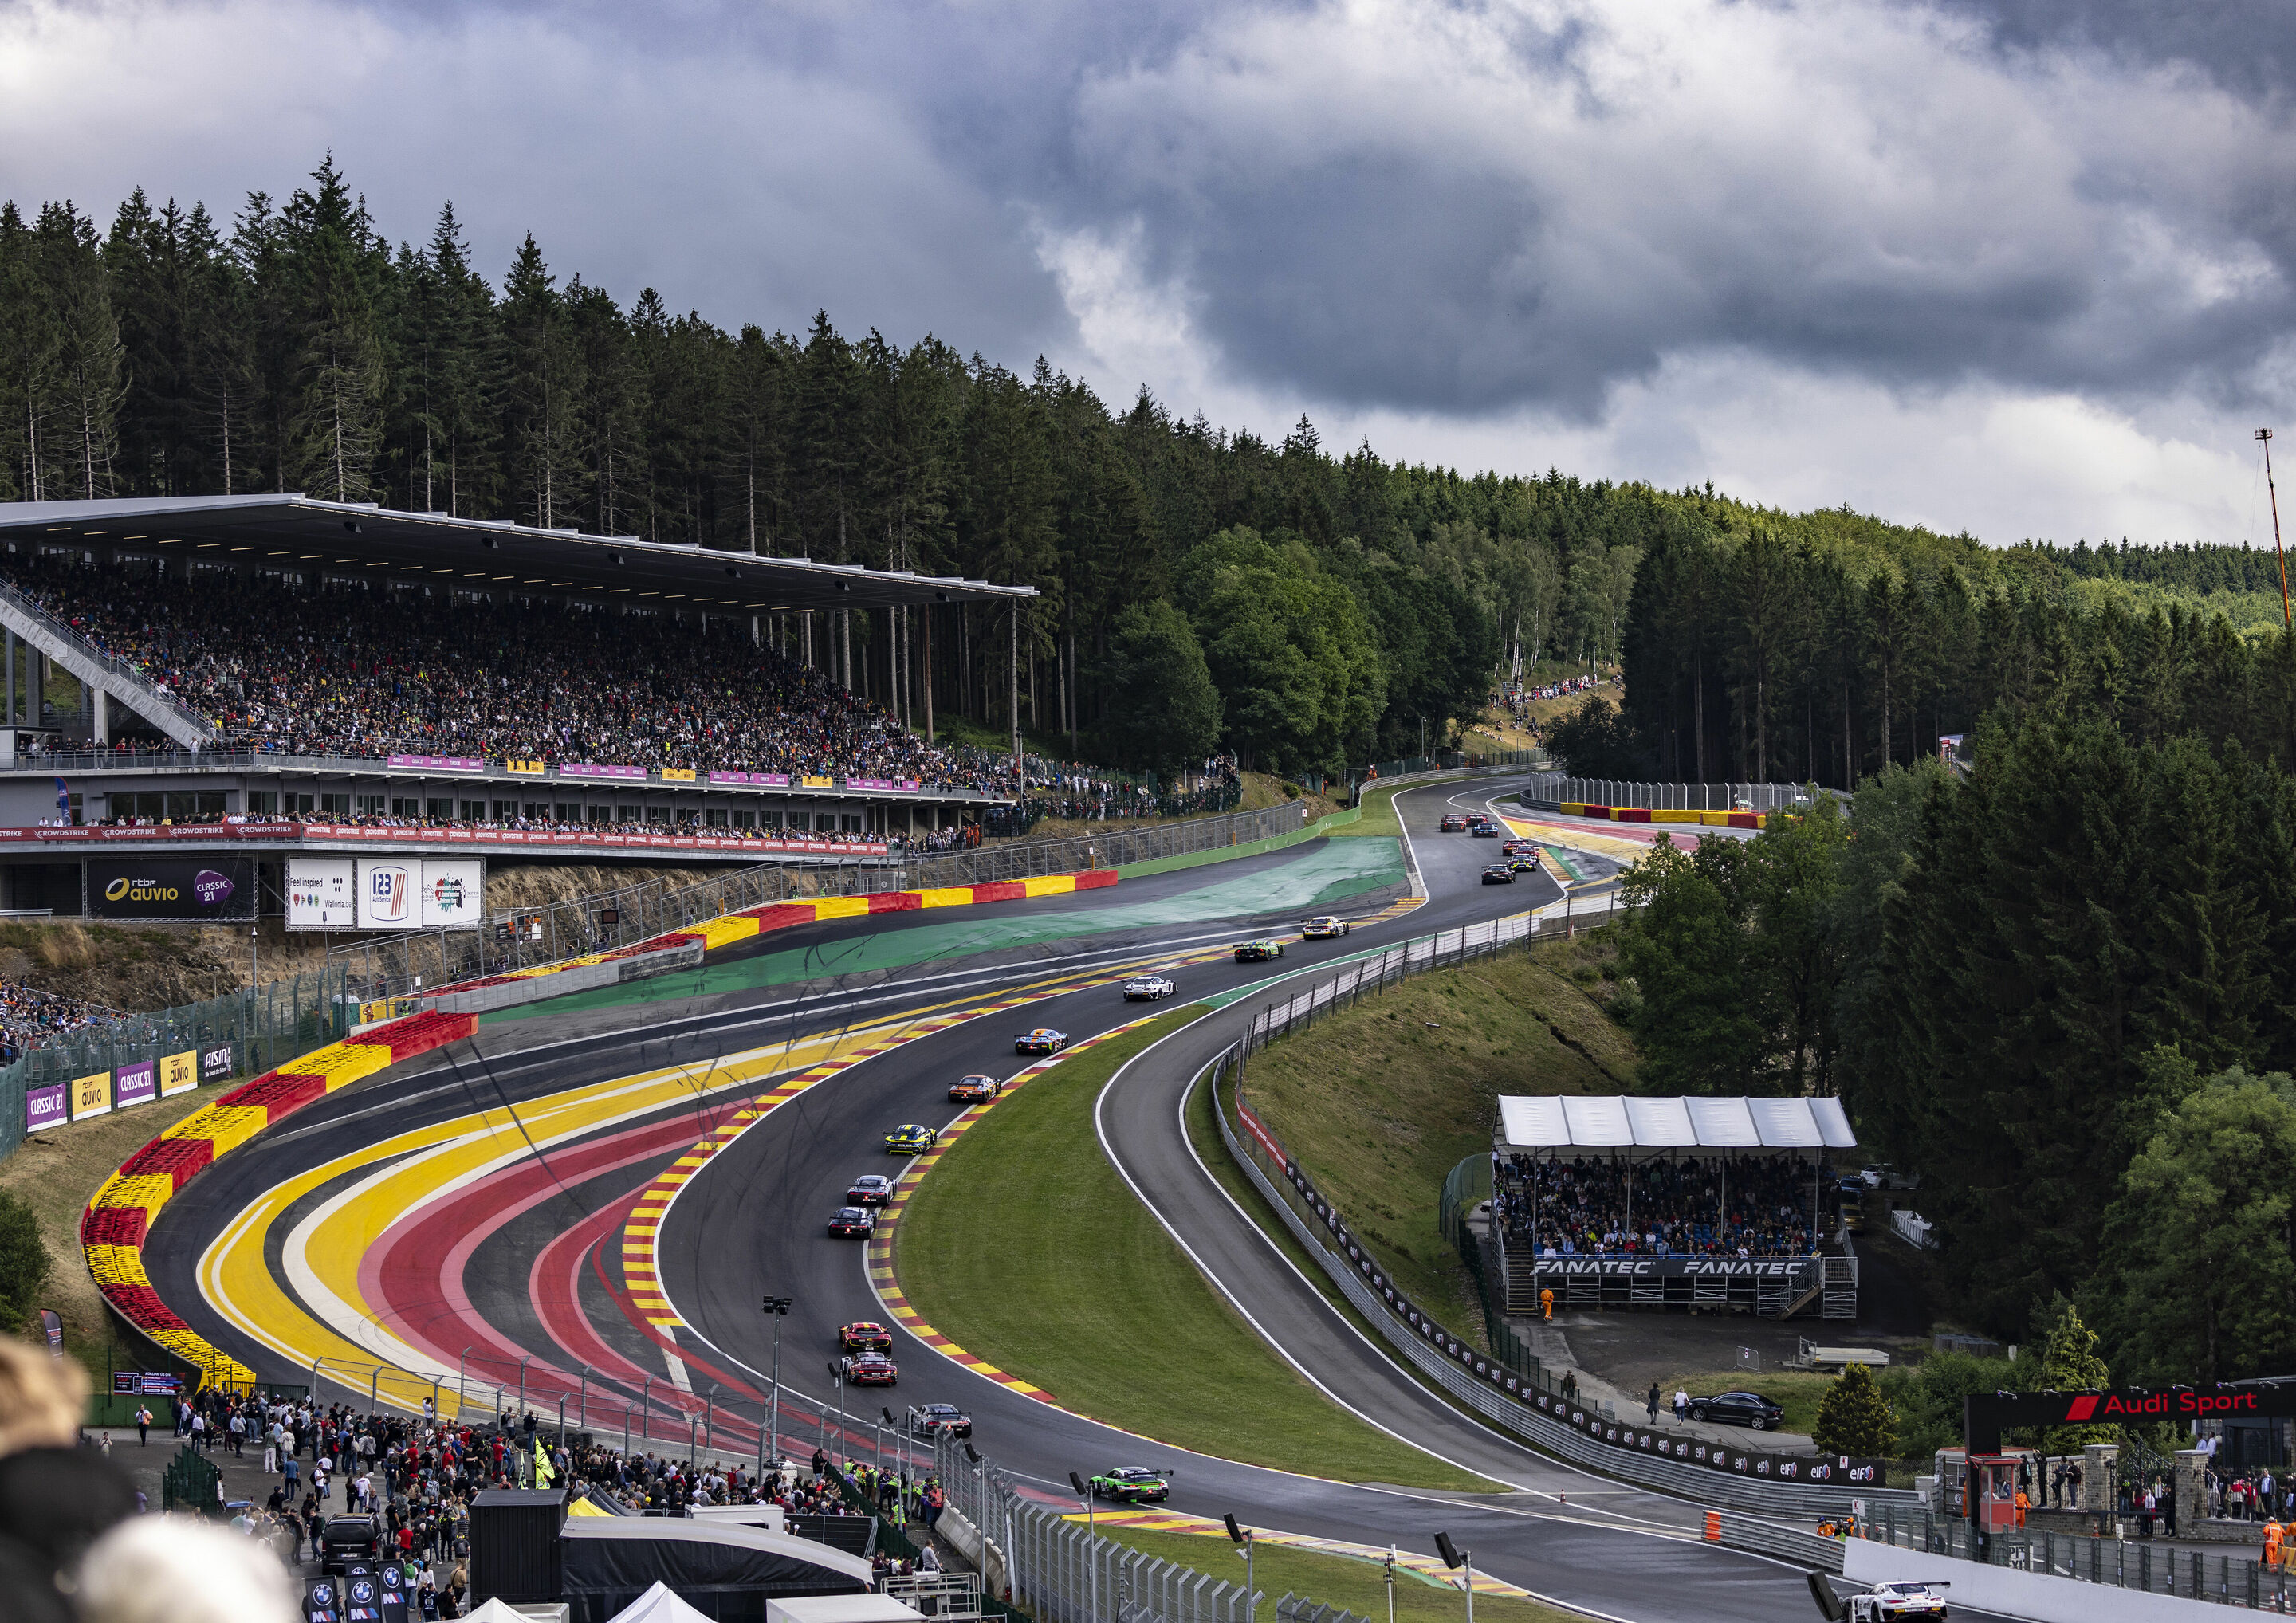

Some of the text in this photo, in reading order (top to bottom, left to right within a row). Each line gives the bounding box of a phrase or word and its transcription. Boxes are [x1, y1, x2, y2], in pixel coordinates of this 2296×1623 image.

[197, 880, 228, 892] CLASSIC
[290, 878, 323, 889] Feel inspired
[130, 888, 179, 901] auvio
[204, 891, 215, 901] 21
[325, 900, 351, 908] Wallonia.be
[205, 1048, 227, 1068] AISIN
[121, 1070, 151, 1092] CLASSIC 21
[170, 1066, 189, 1083] auvio
[82, 1089, 101, 1106] auvio
[31, 1094, 63, 1116] CLASSIC 21
[1535, 1261, 1652, 1274] FANATEC
[1683, 1261, 1802, 1274] FANATEC
[2103, 1392, 2257, 1415] Audi Sport
[1735, 1458, 1743, 1471] elf
[1780, 1464, 1791, 1475] elf
[1811, 1466, 1823, 1478] elf
[1850, 1468, 1865, 1480] elf
